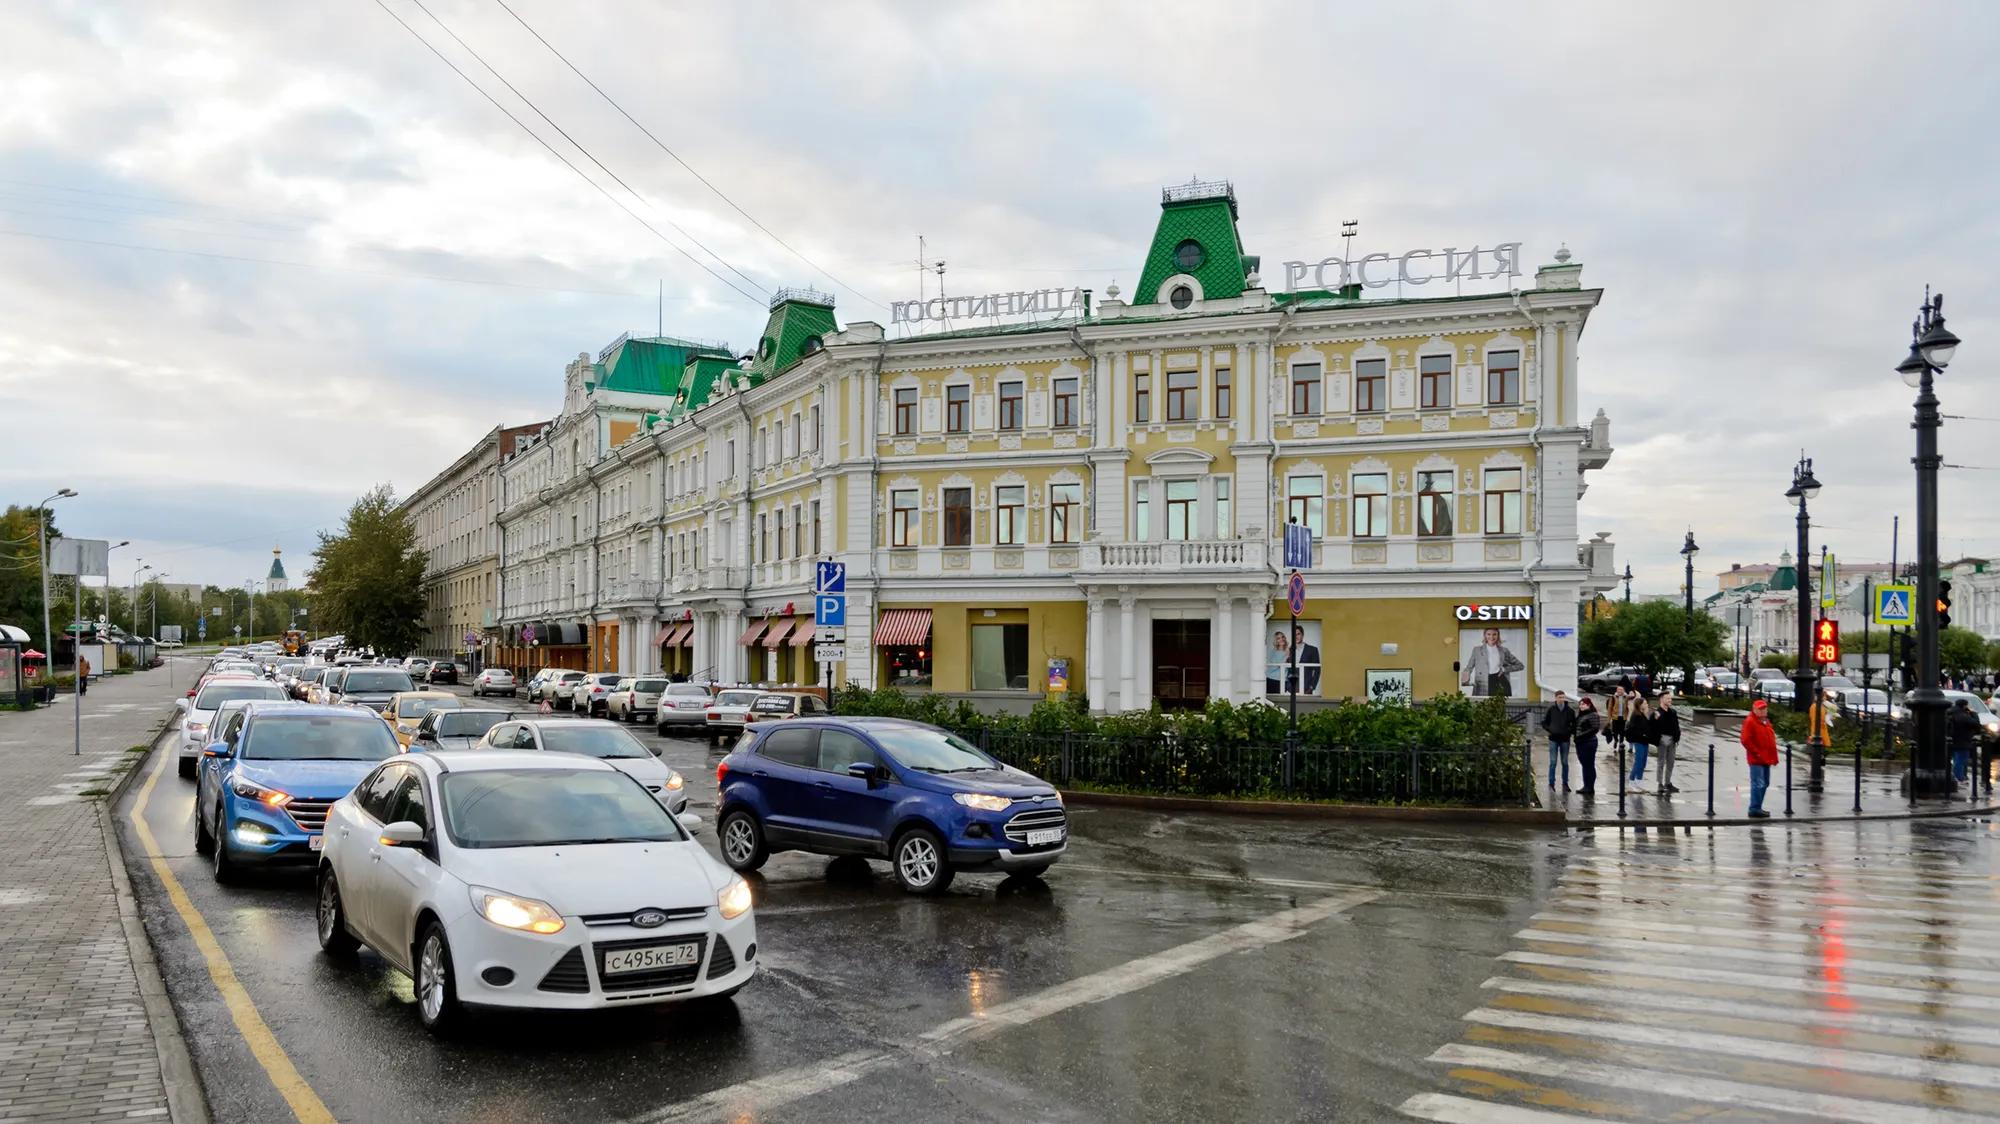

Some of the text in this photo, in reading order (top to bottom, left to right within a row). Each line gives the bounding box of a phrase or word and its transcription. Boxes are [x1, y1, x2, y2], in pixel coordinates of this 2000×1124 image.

[889, 242, 1522, 324] ГОСТИНИЦА РОССИЯ
[1817, 644, 1835, 660] 28
